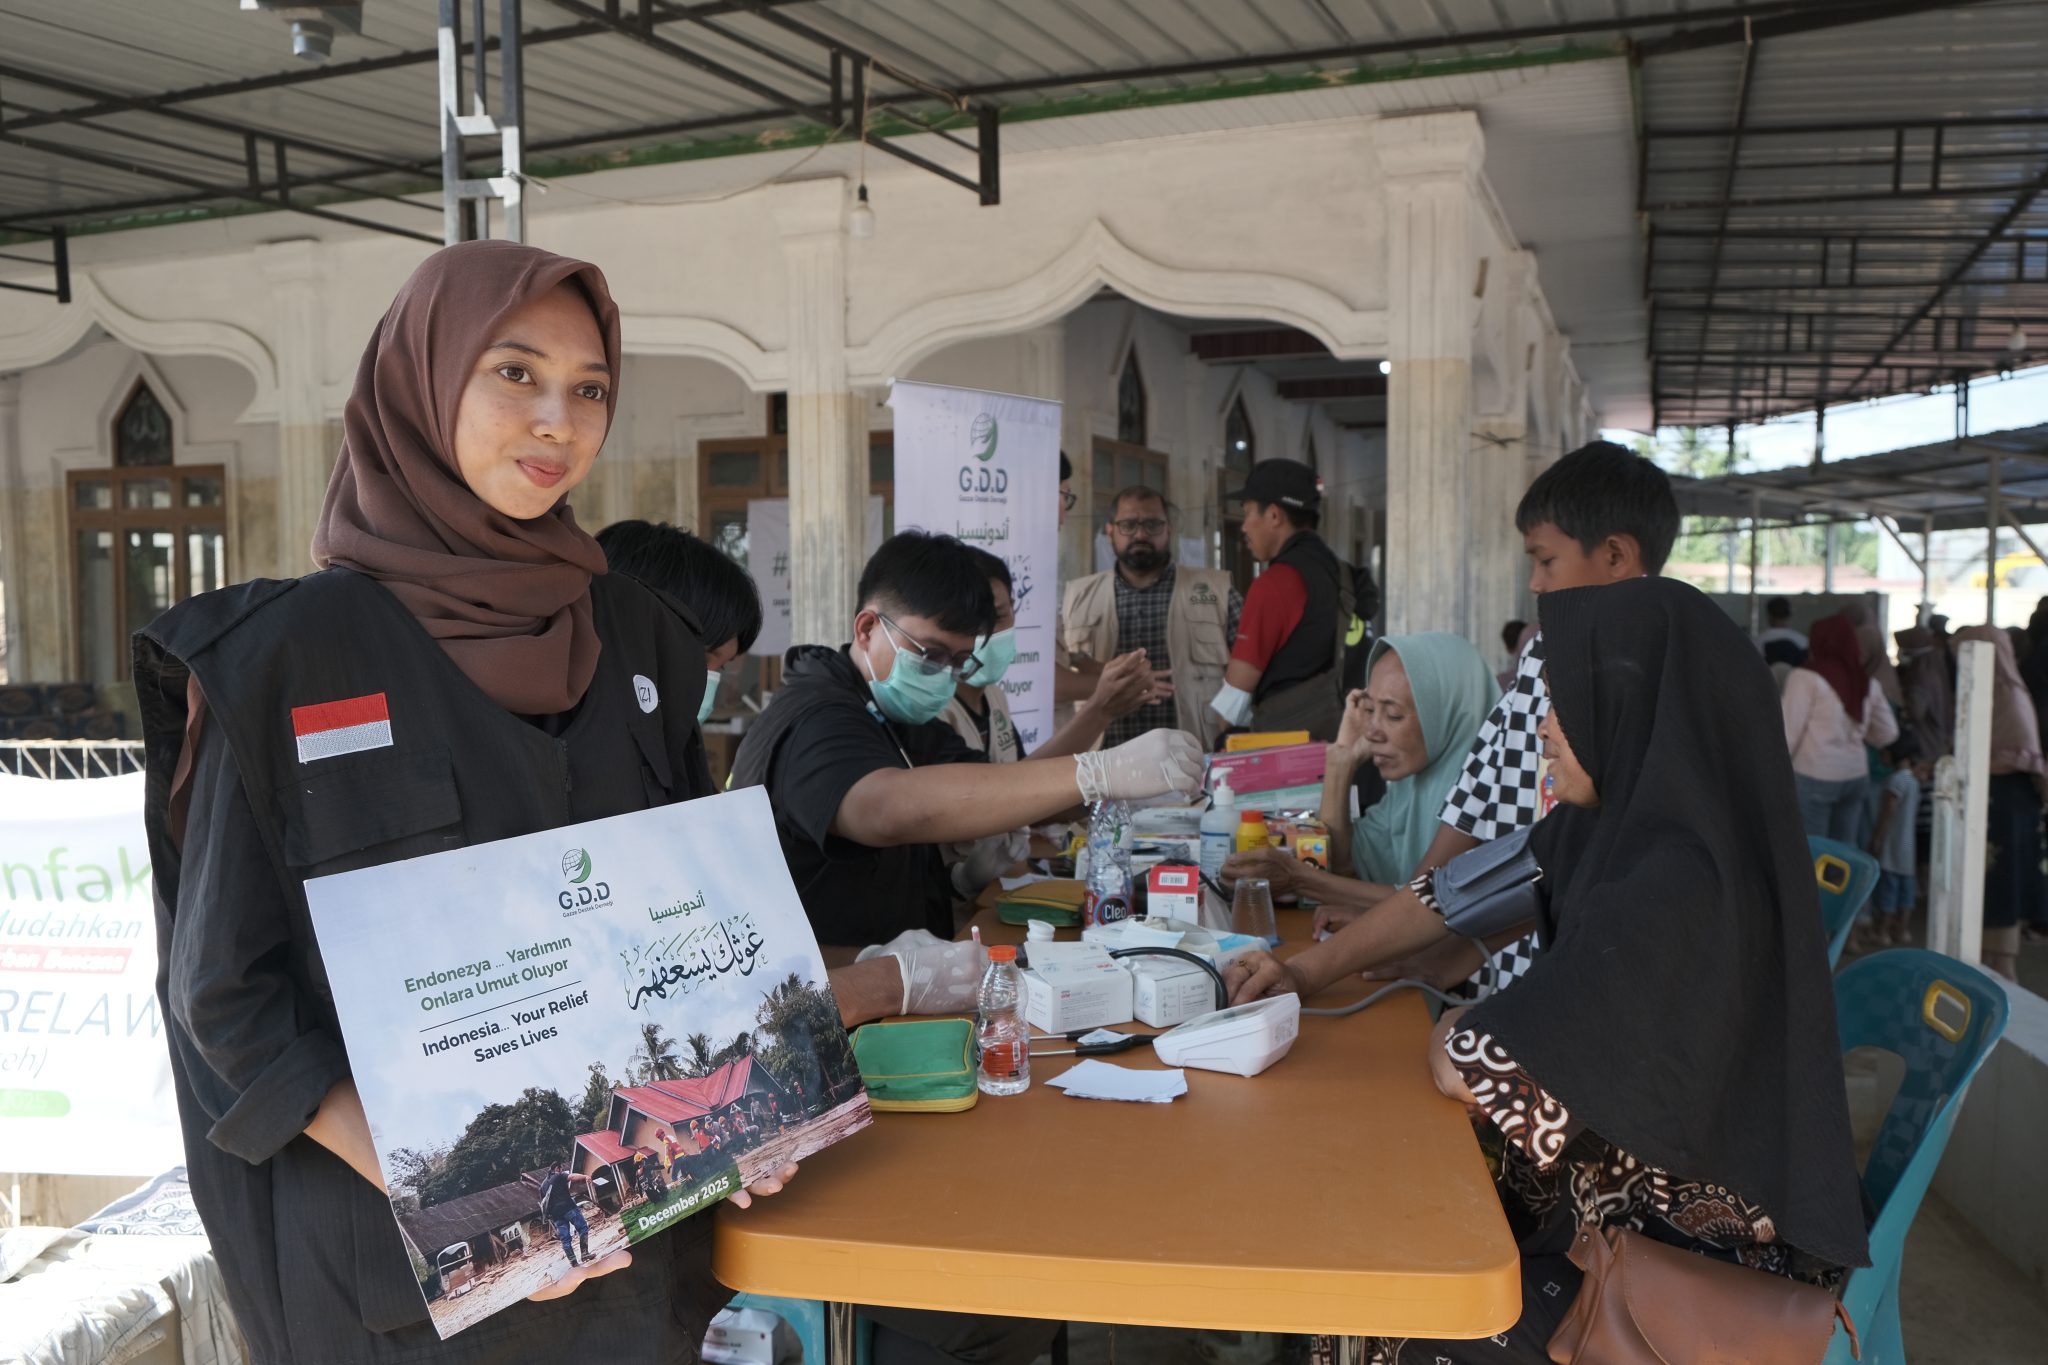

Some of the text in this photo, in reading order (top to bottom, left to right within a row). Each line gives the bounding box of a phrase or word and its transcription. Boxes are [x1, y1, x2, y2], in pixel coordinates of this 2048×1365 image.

[959, 466, 1008, 494] G.D.D
[1020, 728, 1038, 744] lief
[558, 881, 611, 910] G.D.D
[648, 889, 706, 924] أندونيسيا
[1104, 904, 1127, 920] Cleo
[404, 959, 492, 993] Endonezya
[506, 936, 572, 964] Yardımın
[420, 958, 569, 1011] Onlara Umut Oluyor
[511, 1006, 546, 1026] Your
[547, 990, 589, 1015] Relief
[473, 1025, 558, 1063] Saves Lives
[0, 1046, 48, 1079] eh)
[638, 1176, 730, 1231] December 2025
